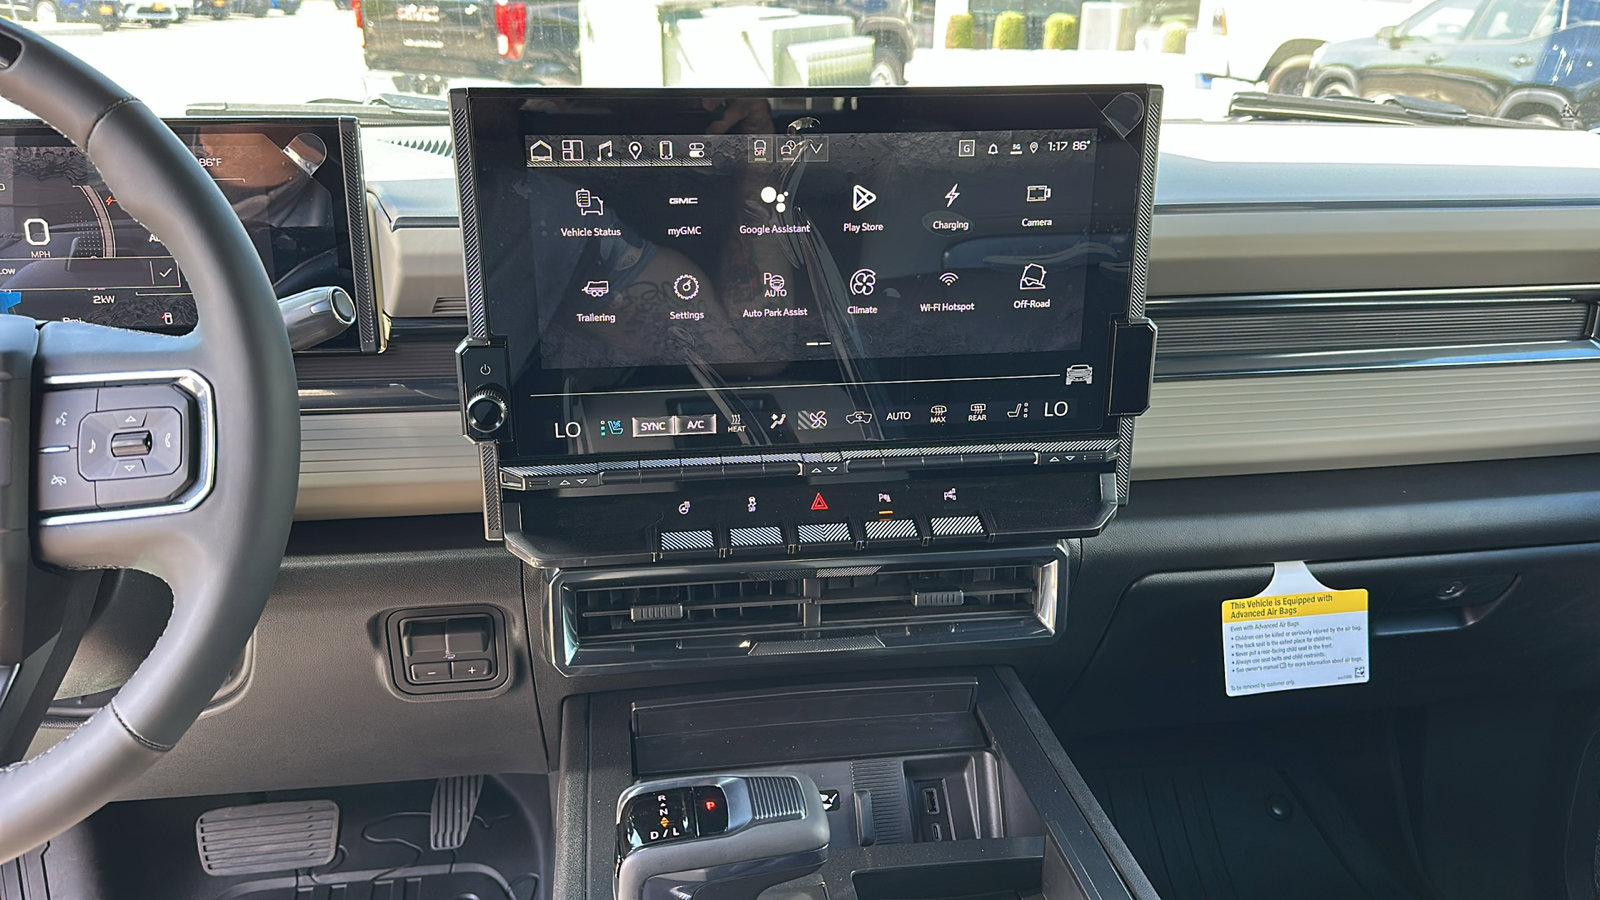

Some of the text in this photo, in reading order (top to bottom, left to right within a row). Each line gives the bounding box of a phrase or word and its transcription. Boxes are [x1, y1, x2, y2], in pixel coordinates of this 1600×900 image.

[1048, 141, 1068, 151] 1:17
[933, 220, 969, 231] Charging
[1022, 217, 1053, 227] Camera
[561, 226, 621, 238] Vehicle Status
[668, 226, 702, 236] myGMC
[739, 223, 811, 235] Google Assistant
[844, 222, 884, 233] Play Store
[31, 250, 51, 258] MPH
[765, 289, 788, 298] AUTO
[93, 295, 115, 304] 2kW
[1014, 299, 1051, 309] Off-Road
[743, 307, 808, 318] Auto Park Assist
[847, 305, 878, 315] Climate
[920, 302, 976, 313] Wi-Fi Hotspot
[577, 313, 616, 324] Trailering
[670, 310, 705, 321] Settings
[1044, 401, 1069, 418] LO
[887, 411, 911, 422] AUTO
[930, 416, 947, 424] MAX
[968, 414, 987, 422] REAR
[641, 421, 667, 432] SYNC
[687, 420, 705, 429] A/C
[727, 425, 746, 433] HEAT
[554, 421, 582, 439] LO
[1231, 594, 1333, 610] This Vehicle is Equipped with
[1231, 606, 1297, 619] Advanced Air Bags
[1254, 622, 1279, 630] Advanced
[705, 801, 716, 811] P
[659, 808, 669, 816] N
